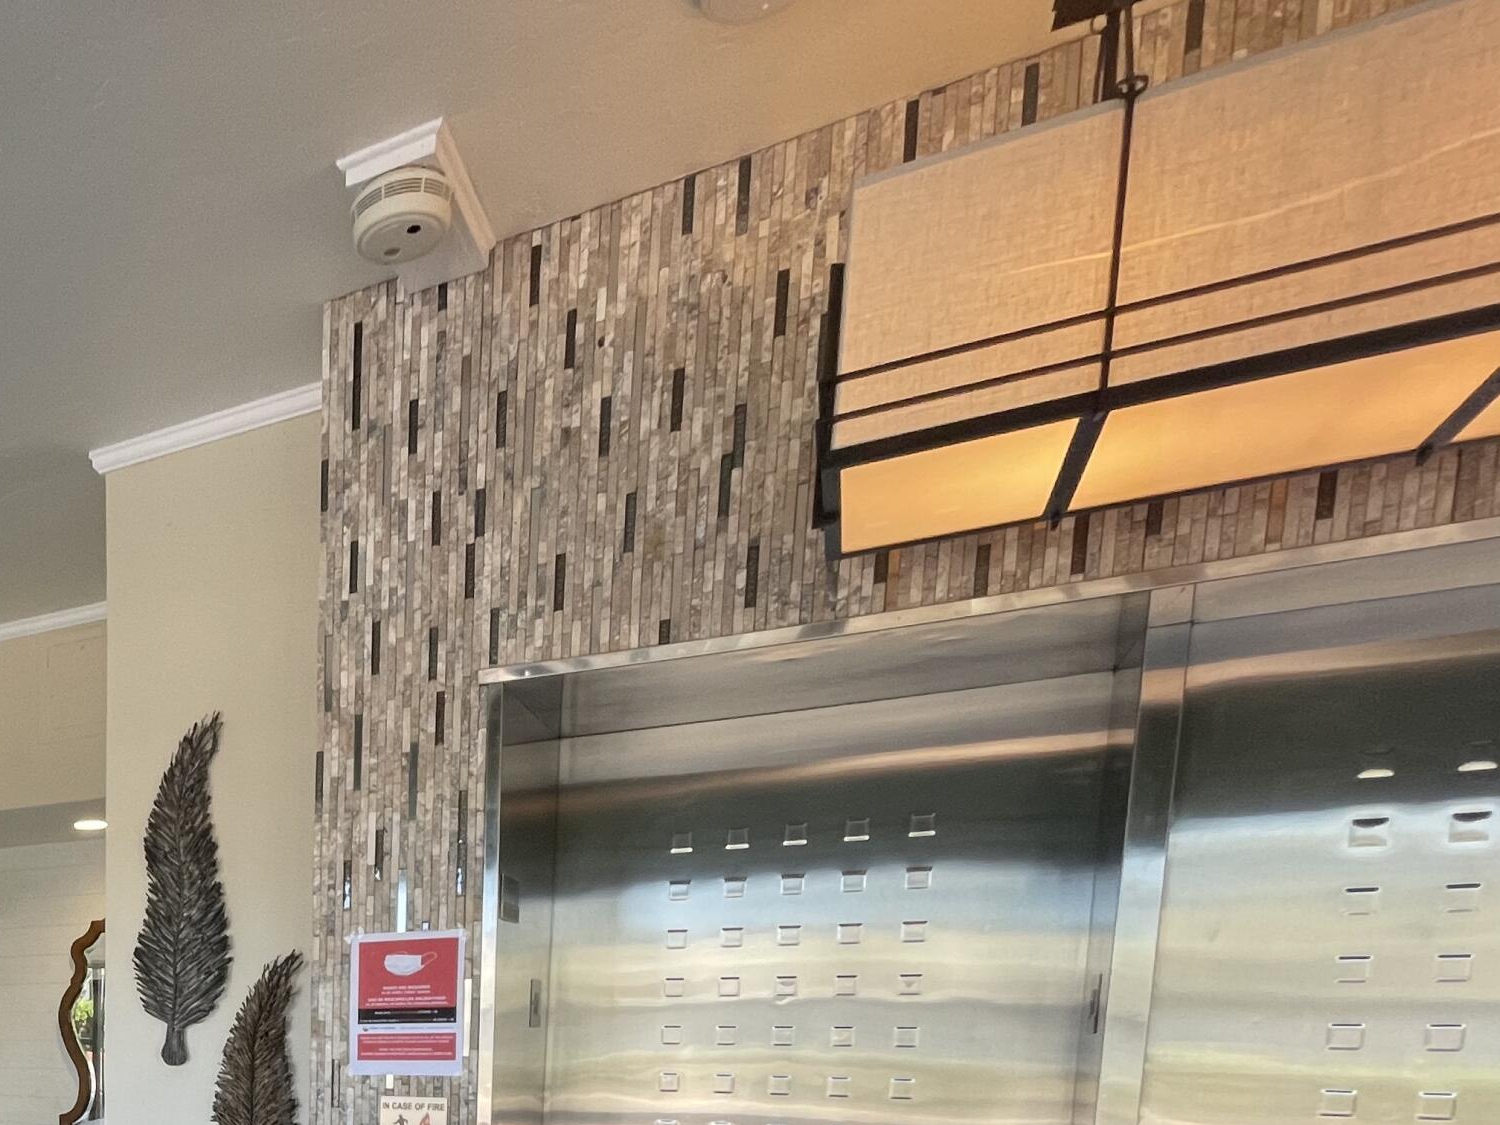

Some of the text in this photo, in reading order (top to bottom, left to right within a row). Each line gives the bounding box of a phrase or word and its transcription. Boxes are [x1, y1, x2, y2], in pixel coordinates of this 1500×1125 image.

[391, 1102, 412, 1110] CASE
[414, 1102, 425, 1111] OF
[427, 1103, 445, 1111] FIRE
